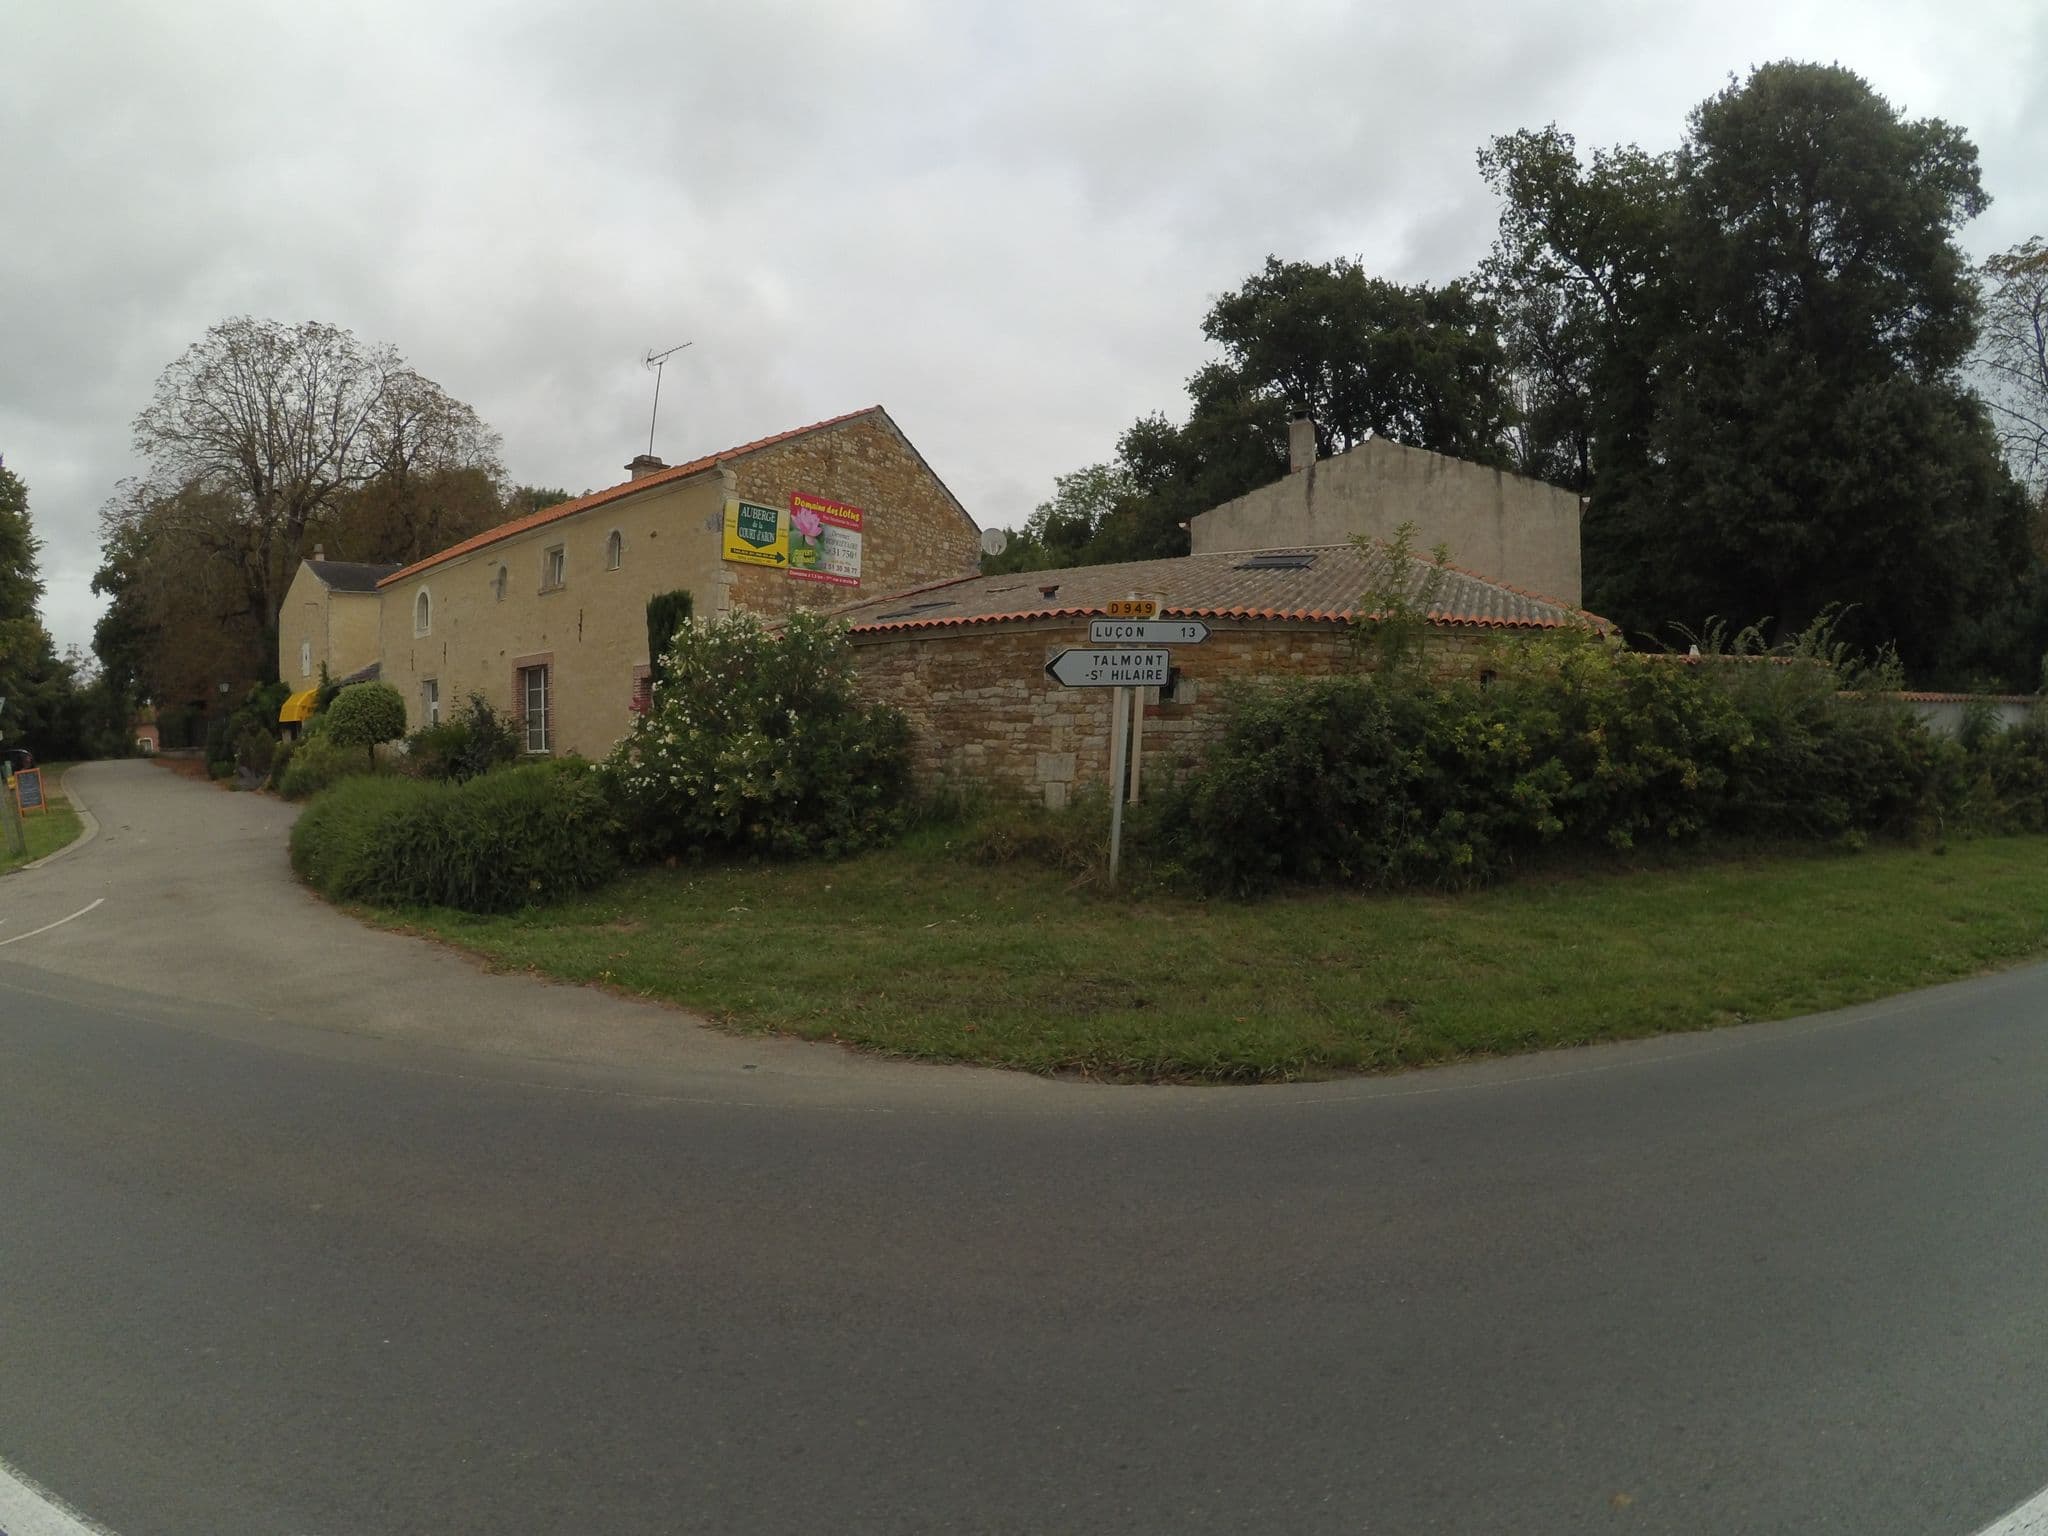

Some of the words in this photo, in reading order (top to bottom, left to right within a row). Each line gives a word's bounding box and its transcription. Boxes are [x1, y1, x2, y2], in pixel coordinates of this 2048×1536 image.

[740, 506, 776, 523] AUBERGE
[794, 496, 826, 513] Domaine
[826, 504, 839, 516] des
[839, 506, 860, 522] Lotus
[1112, 603, 1119, 614] D
[1124, 603, 1153, 614] 949
[1096, 626, 1145, 639] LUÇON
[1181, 627, 1196, 638] 13
[1093, 655, 1163, 666] TALMONT
[1112, 669, 1163, 680] HILAIRE
